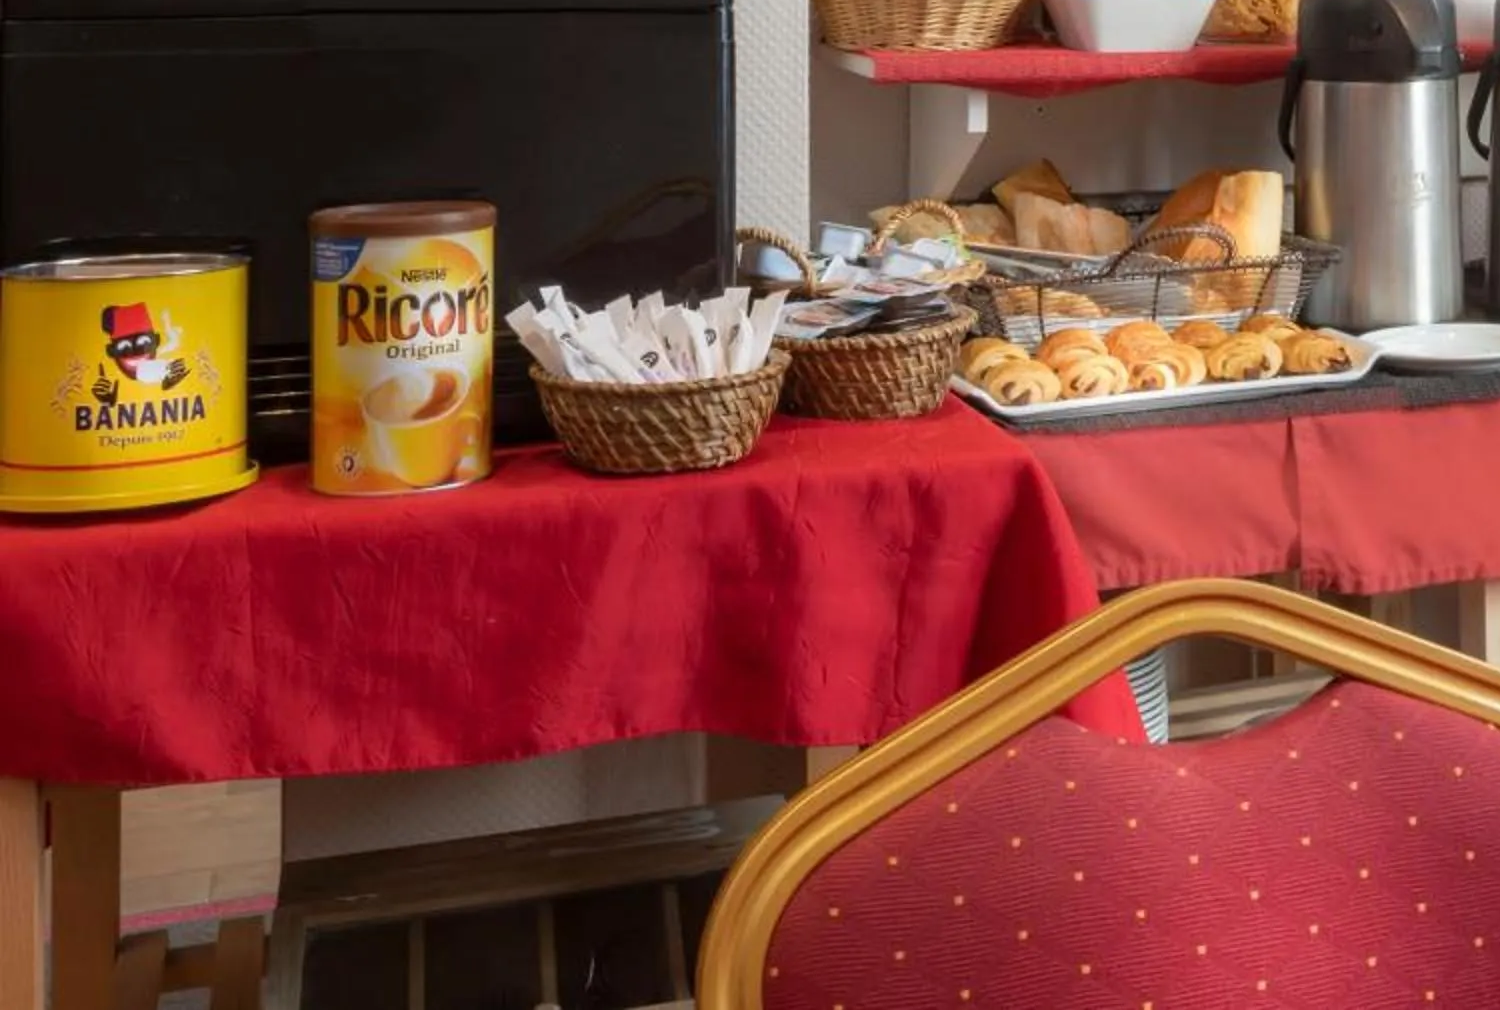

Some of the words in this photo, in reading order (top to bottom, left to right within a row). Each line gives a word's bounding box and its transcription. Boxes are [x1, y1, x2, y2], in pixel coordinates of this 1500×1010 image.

[401, 267, 447, 284] Nestlé
[337, 270, 489, 347] Ricoré
[386, 340, 460, 361] Original
[75, 393, 206, 432] BANANIA
[97, 433, 155, 452] Depuis
